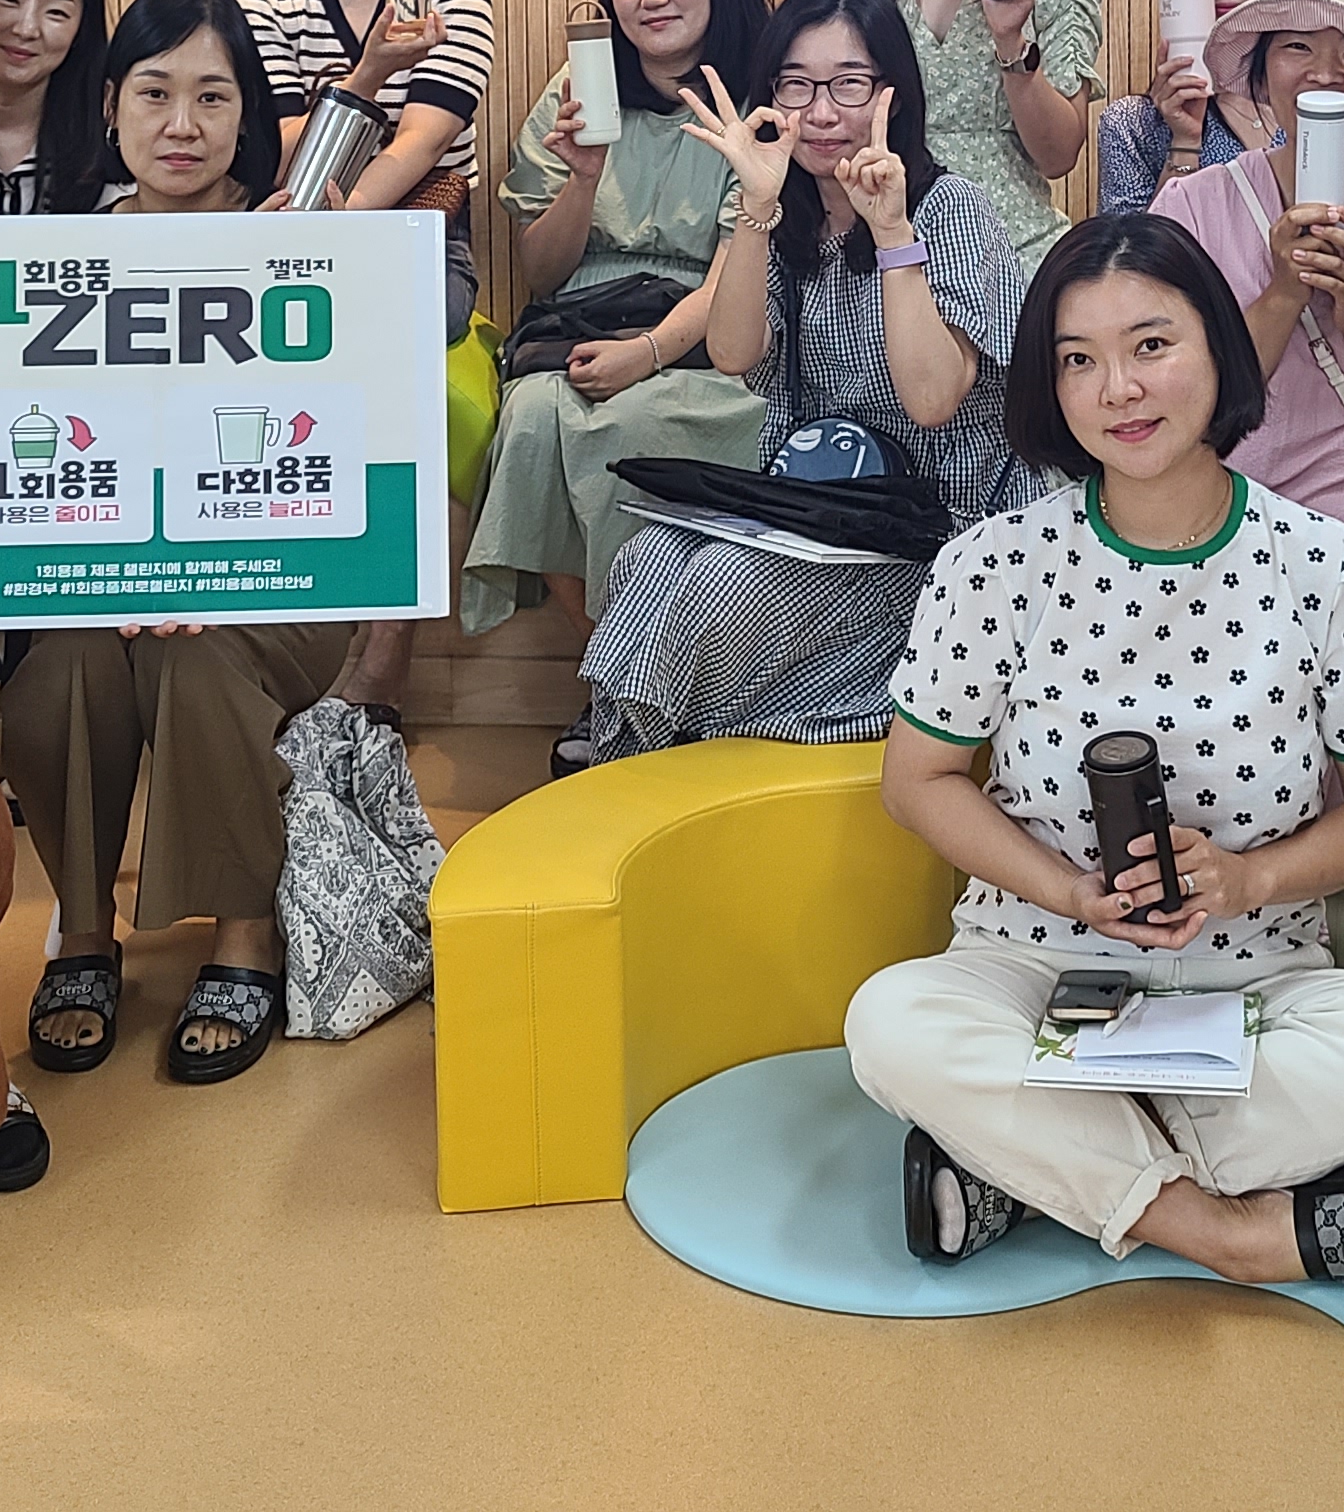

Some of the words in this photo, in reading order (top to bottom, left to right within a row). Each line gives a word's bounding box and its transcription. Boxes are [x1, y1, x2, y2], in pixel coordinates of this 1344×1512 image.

[265, 257, 334, 280] 챌린지
[22, 284, 333, 367] ZERO
[197, 455, 333, 495] 다회용품
[54, 504, 121, 524] 줄이고
[197, 501, 264, 521] 사용은
[268, 499, 334, 519] 늘리고
[36, 563, 86, 578] 1회용품
[90, 563, 120, 578] 제로
[185, 560, 229, 576] 함께해
[232, 559, 282, 574] 주세요!
[3, 581, 58, 597] #환경부
